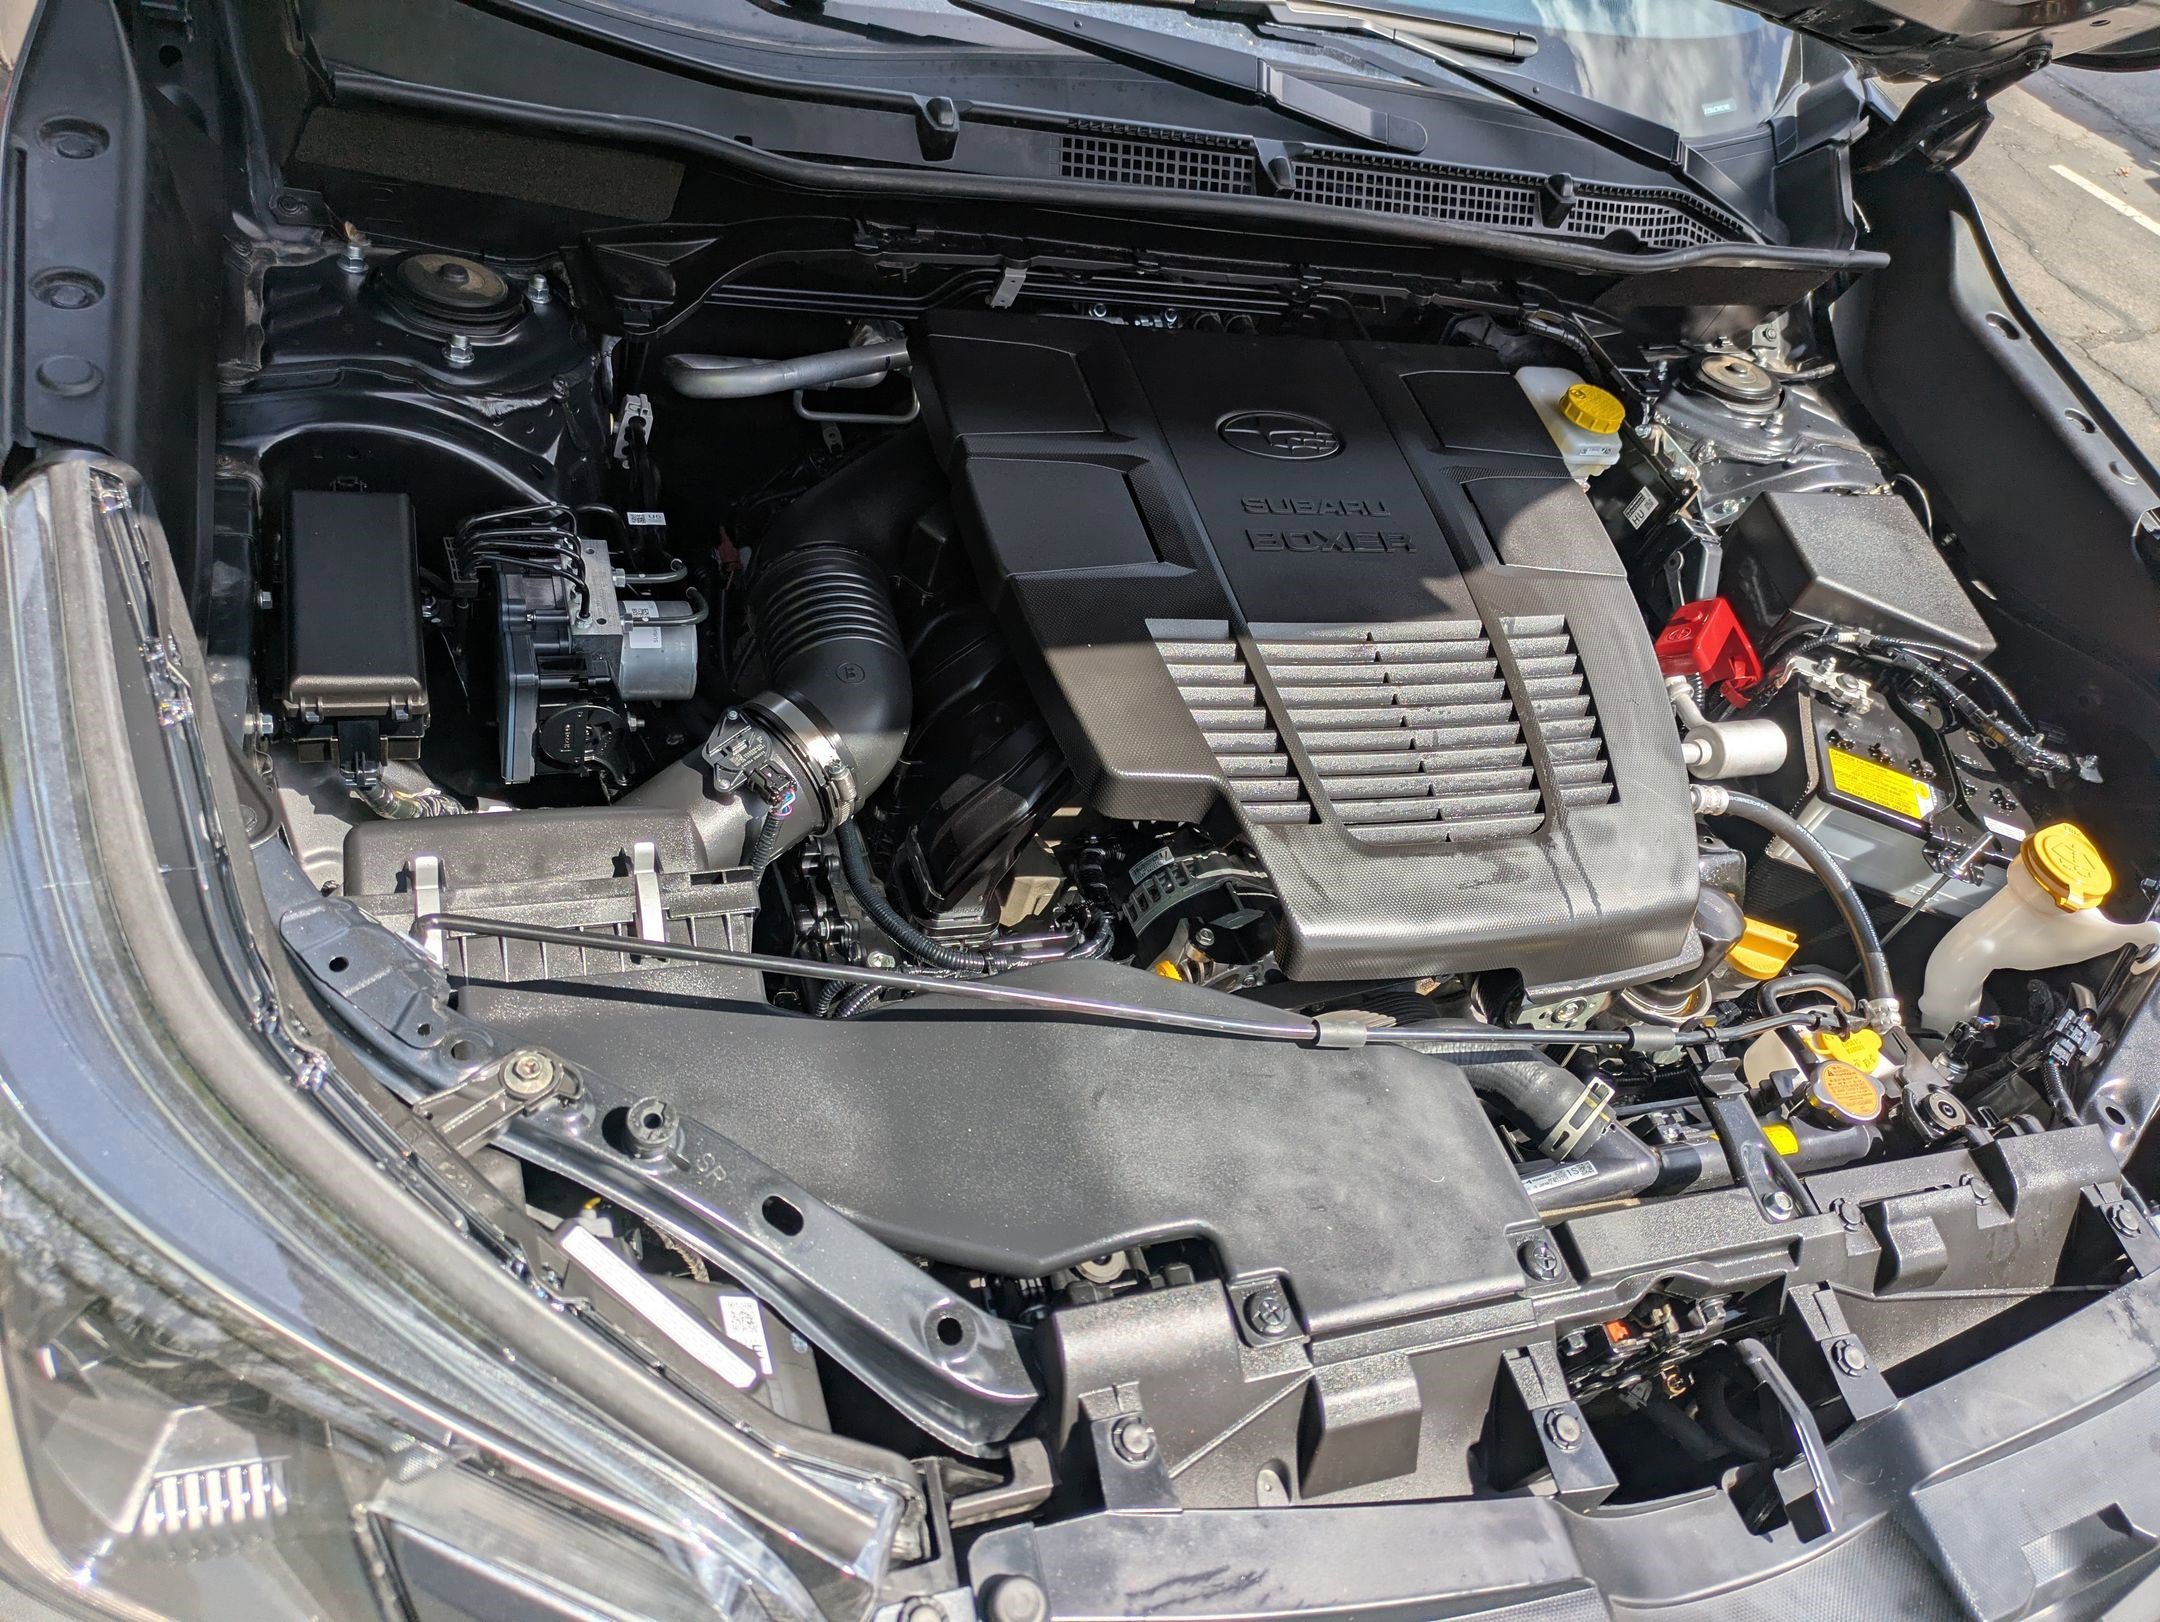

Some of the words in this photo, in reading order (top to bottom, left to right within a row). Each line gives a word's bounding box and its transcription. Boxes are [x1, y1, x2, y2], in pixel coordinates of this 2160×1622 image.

[1240, 498, 1391, 517] SUBARU
[1631, 509, 1646, 526] HU
[1245, 529, 1417, 553] BOXER
[696, 1152, 728, 1188] SR
